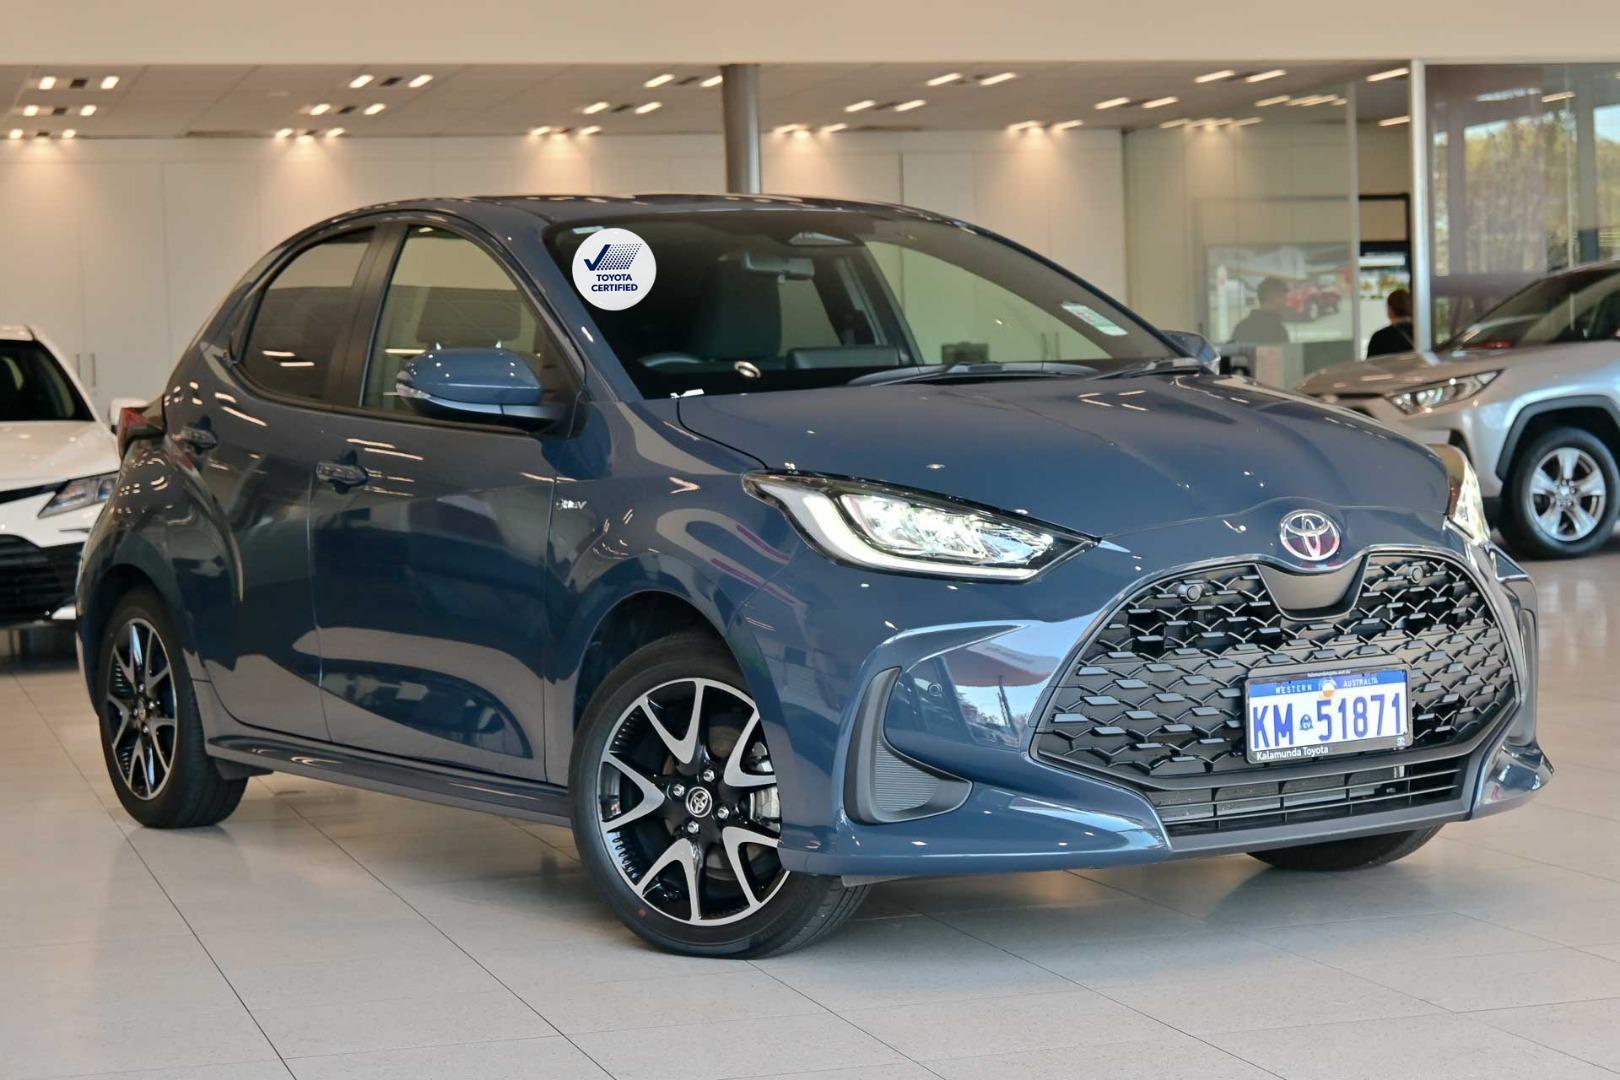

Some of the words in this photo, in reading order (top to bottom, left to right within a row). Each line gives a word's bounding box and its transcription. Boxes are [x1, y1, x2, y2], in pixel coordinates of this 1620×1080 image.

[1275, 684, 1313, 694] WESTERN
[1343, 677, 1378, 688] AUSTRALIA
[1253, 703, 1294, 749] KM
[1316, 692, 1401, 742] 51871
[1256, 747, 1302, 761] Kalamunda
[1303, 745, 1329, 758] Toyota
